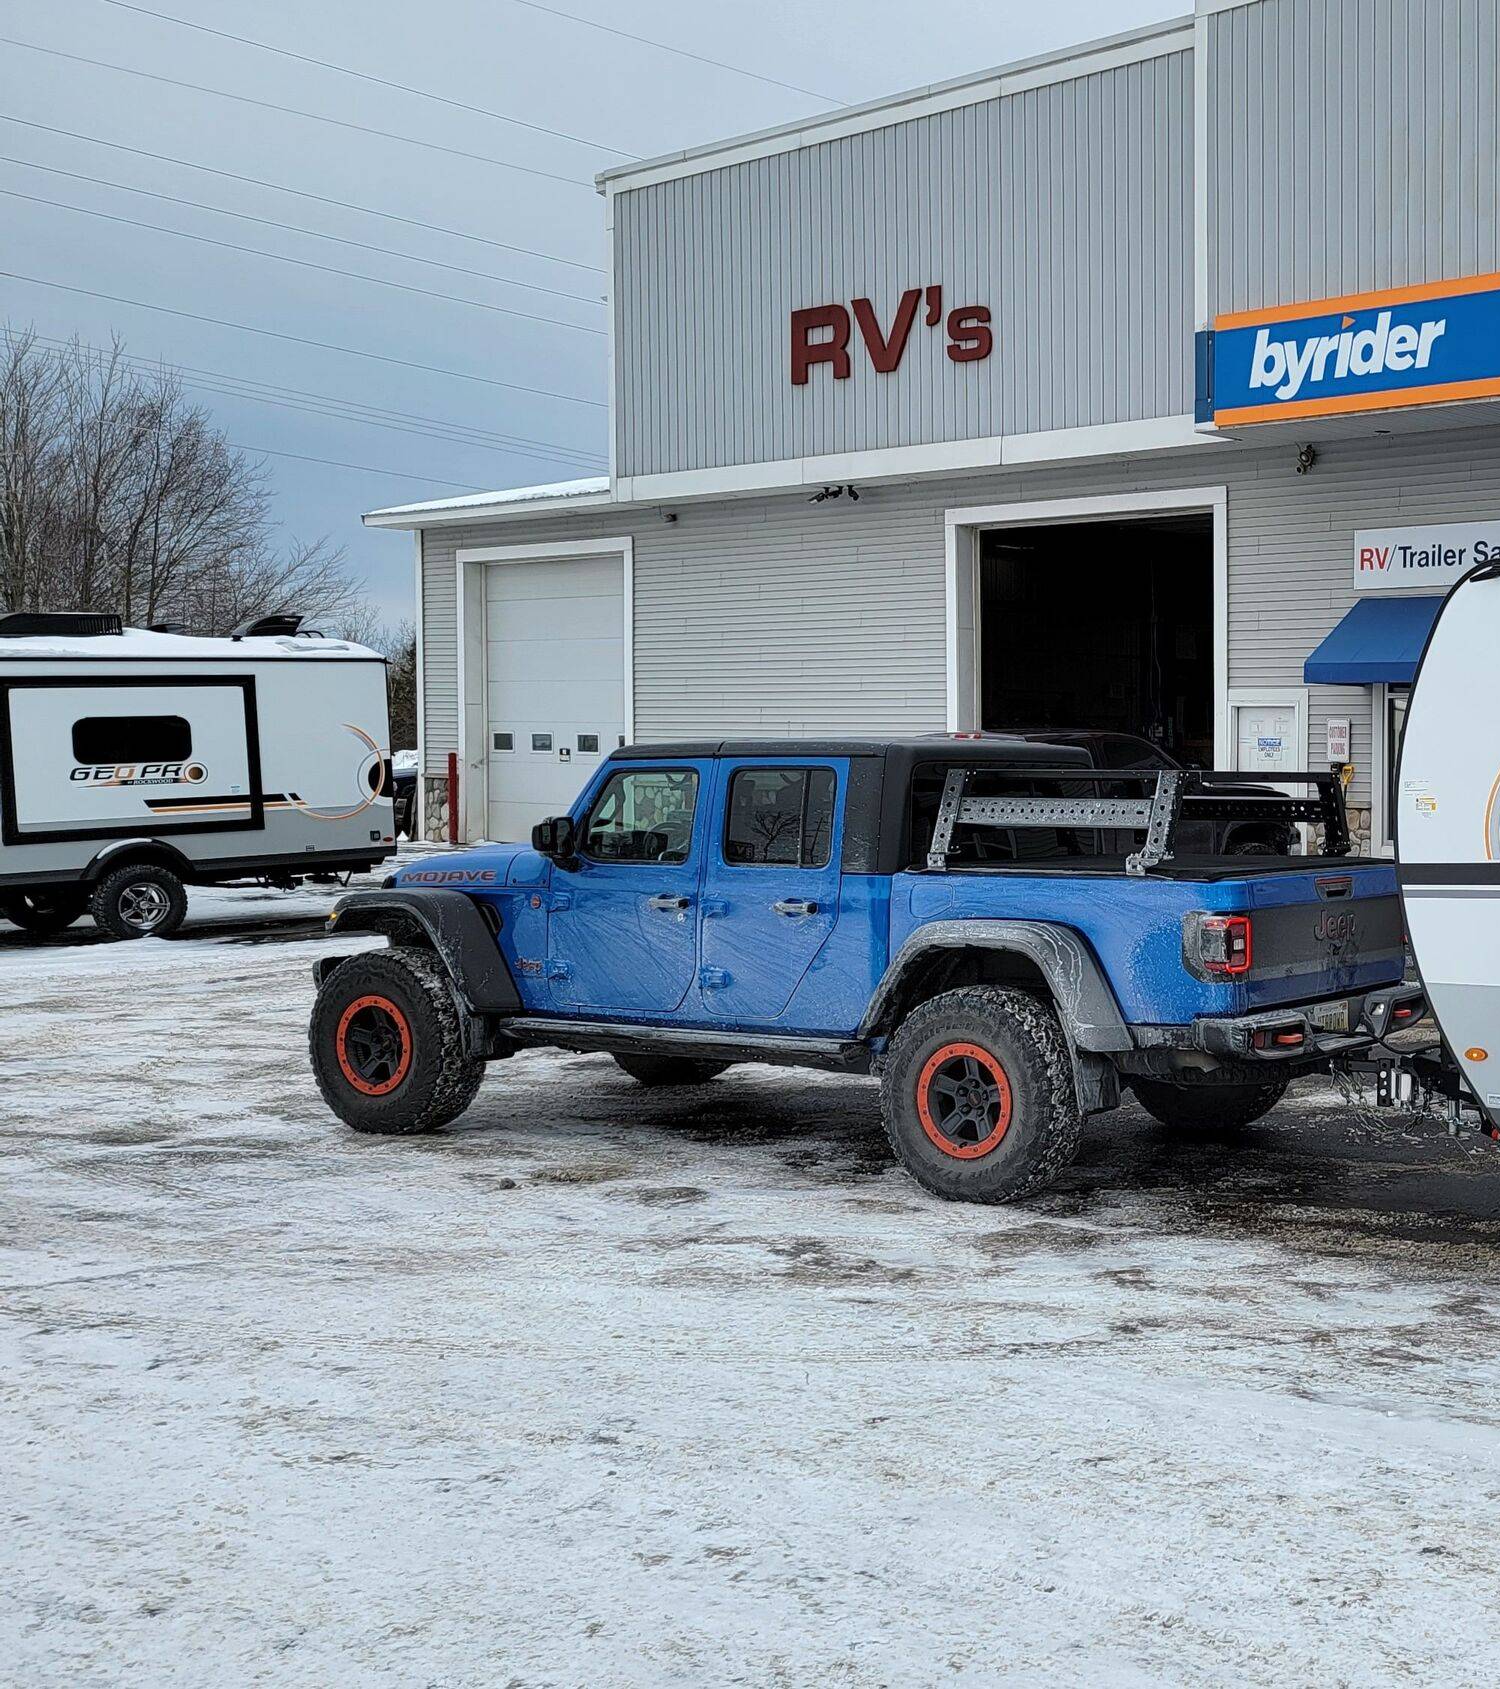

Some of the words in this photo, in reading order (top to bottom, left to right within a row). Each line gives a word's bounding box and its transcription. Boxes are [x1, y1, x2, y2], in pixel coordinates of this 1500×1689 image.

[791, 285, 993, 385] RV's
[1249, 311, 1446, 400] byrider
[401, 870, 497, 883] MOJAVE
[1314, 910, 1357, 941] Jeep
